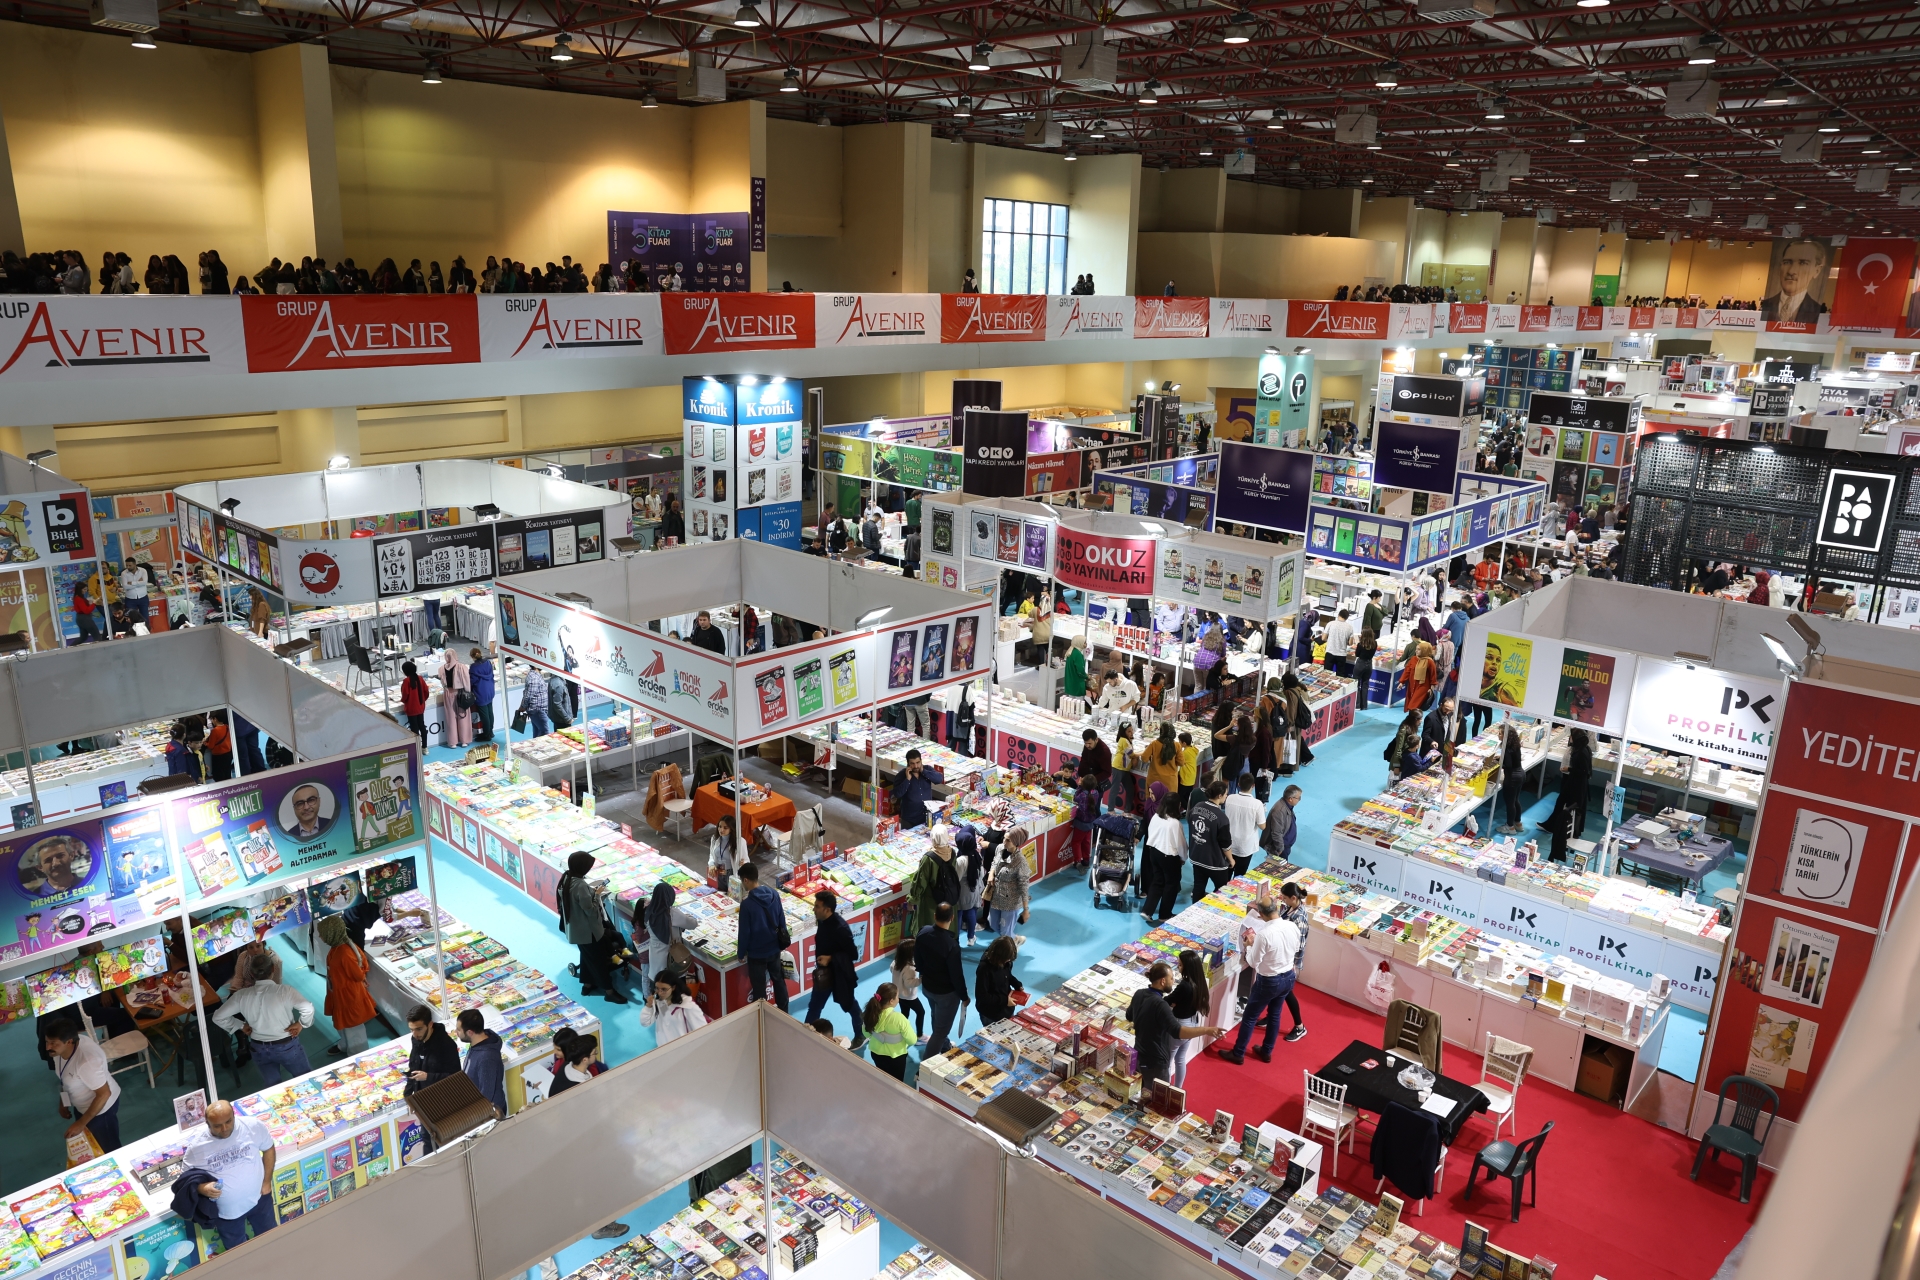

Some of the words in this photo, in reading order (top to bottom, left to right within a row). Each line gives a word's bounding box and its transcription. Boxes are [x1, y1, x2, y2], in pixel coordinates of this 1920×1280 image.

[648, 238, 671, 246] FUARI
[716, 238, 733, 246] FUARI
[277, 301, 317, 317] GRUP
[506, 299, 537, 312] GRUP
[684, 298, 711, 310] GRUP
[834, 296, 855, 307] GRUP
[956, 296, 975, 307] GRUP
[1304, 303, 1322, 311] GRUP
[688, 298, 797, 352] AVENIR
[836, 296, 926, 344] AVENIR
[958, 296, 1033, 341] AVENIR
[1060, 298, 1123, 338] AVENIR
[1147, 299, 1201, 336] AVENIR
[1220, 301, 1272, 335] AVENIR
[1303, 304, 1376, 336] AVENIR
[1454, 306, 1482, 333] AVENIR
[1490, 306, 1516, 330] AVENIR
[1523, 306, 1546, 330] AVENIR
[1554, 308, 1574, 327] AVENIR
[1704, 310, 1756, 328] AVENIR
[285, 300, 452, 370] AVENIR
[511, 298, 643, 358] AVENIR
[0, 302, 209, 375] AVENIR
[1769, 376, 1804, 384] EPHESU
[690, 399, 729, 418] Kronik
[746, 400, 794, 418] Kronik
[845, 444, 853, 452] Ali
[980, 448, 1012, 458] YKY
[1106, 448, 1128, 459] Ahmet
[904, 453, 921, 465] HARRY
[1045, 459, 1065, 468] Hikmet
[903, 464, 923, 476] POTTER
[1238, 476, 1260, 484] TÜRKİYE
[1268, 481, 1291, 489] BANKASI
[1244, 490, 1259, 498] Kültür
[1260, 492, 1281, 501] Yayınları
[772, 518, 790, 531] %30
[50, 529, 79, 541] Bilgi
[768, 530, 795, 541] İNDİRİM
[52, 541, 81, 552] Çocuk
[455, 549, 465, 558] 13
[434, 550, 450, 561] 123
[1074, 542, 1147, 568] DOKUZ
[435, 562, 451, 572] 658
[1073, 562, 1146, 584] YAYINLARI
[436, 573, 451, 583] 789
[456, 571, 465, 580] 11
[530, 642, 548, 658] TRT
[1574, 660, 1601, 669] CRISTIANO
[679, 670, 701, 688] minik
[1562, 664, 1609, 685] RONALDO
[638, 677, 667, 696] erdem
[682, 682, 701, 698] ada
[708, 700, 729, 716] erdem
[1697, 739, 1734, 753] kitaba
[371, 778, 391, 800] BİLGE
[229, 792, 262, 818] HİKMET
[375, 798, 397, 818] HİKMET
[298, 842, 327, 855] MEHMET
[1058, 848, 1074, 859] erde
[1800, 844, 1840, 862] TÜRKLERİN
[290, 849, 338, 868] ALTIPARMAK
[1798, 856, 1815, 868] KISA
[1330, 866, 1397, 894] PROFİLKİTAP
[1795, 868, 1820, 882] TARİHİ
[30, 890, 69, 909] MEHMET
[72, 884, 96, 898] ESEN
[1404, 890, 1476, 920] PROFİLKİTAP
[1483, 917, 1561, 948] PROFİLKİTAP
[1782, 922, 1812, 938] Ottoman
[1812, 931, 1835, 945] Sultans
[1569, 945, 1653, 979] PROFİLKİTAP
